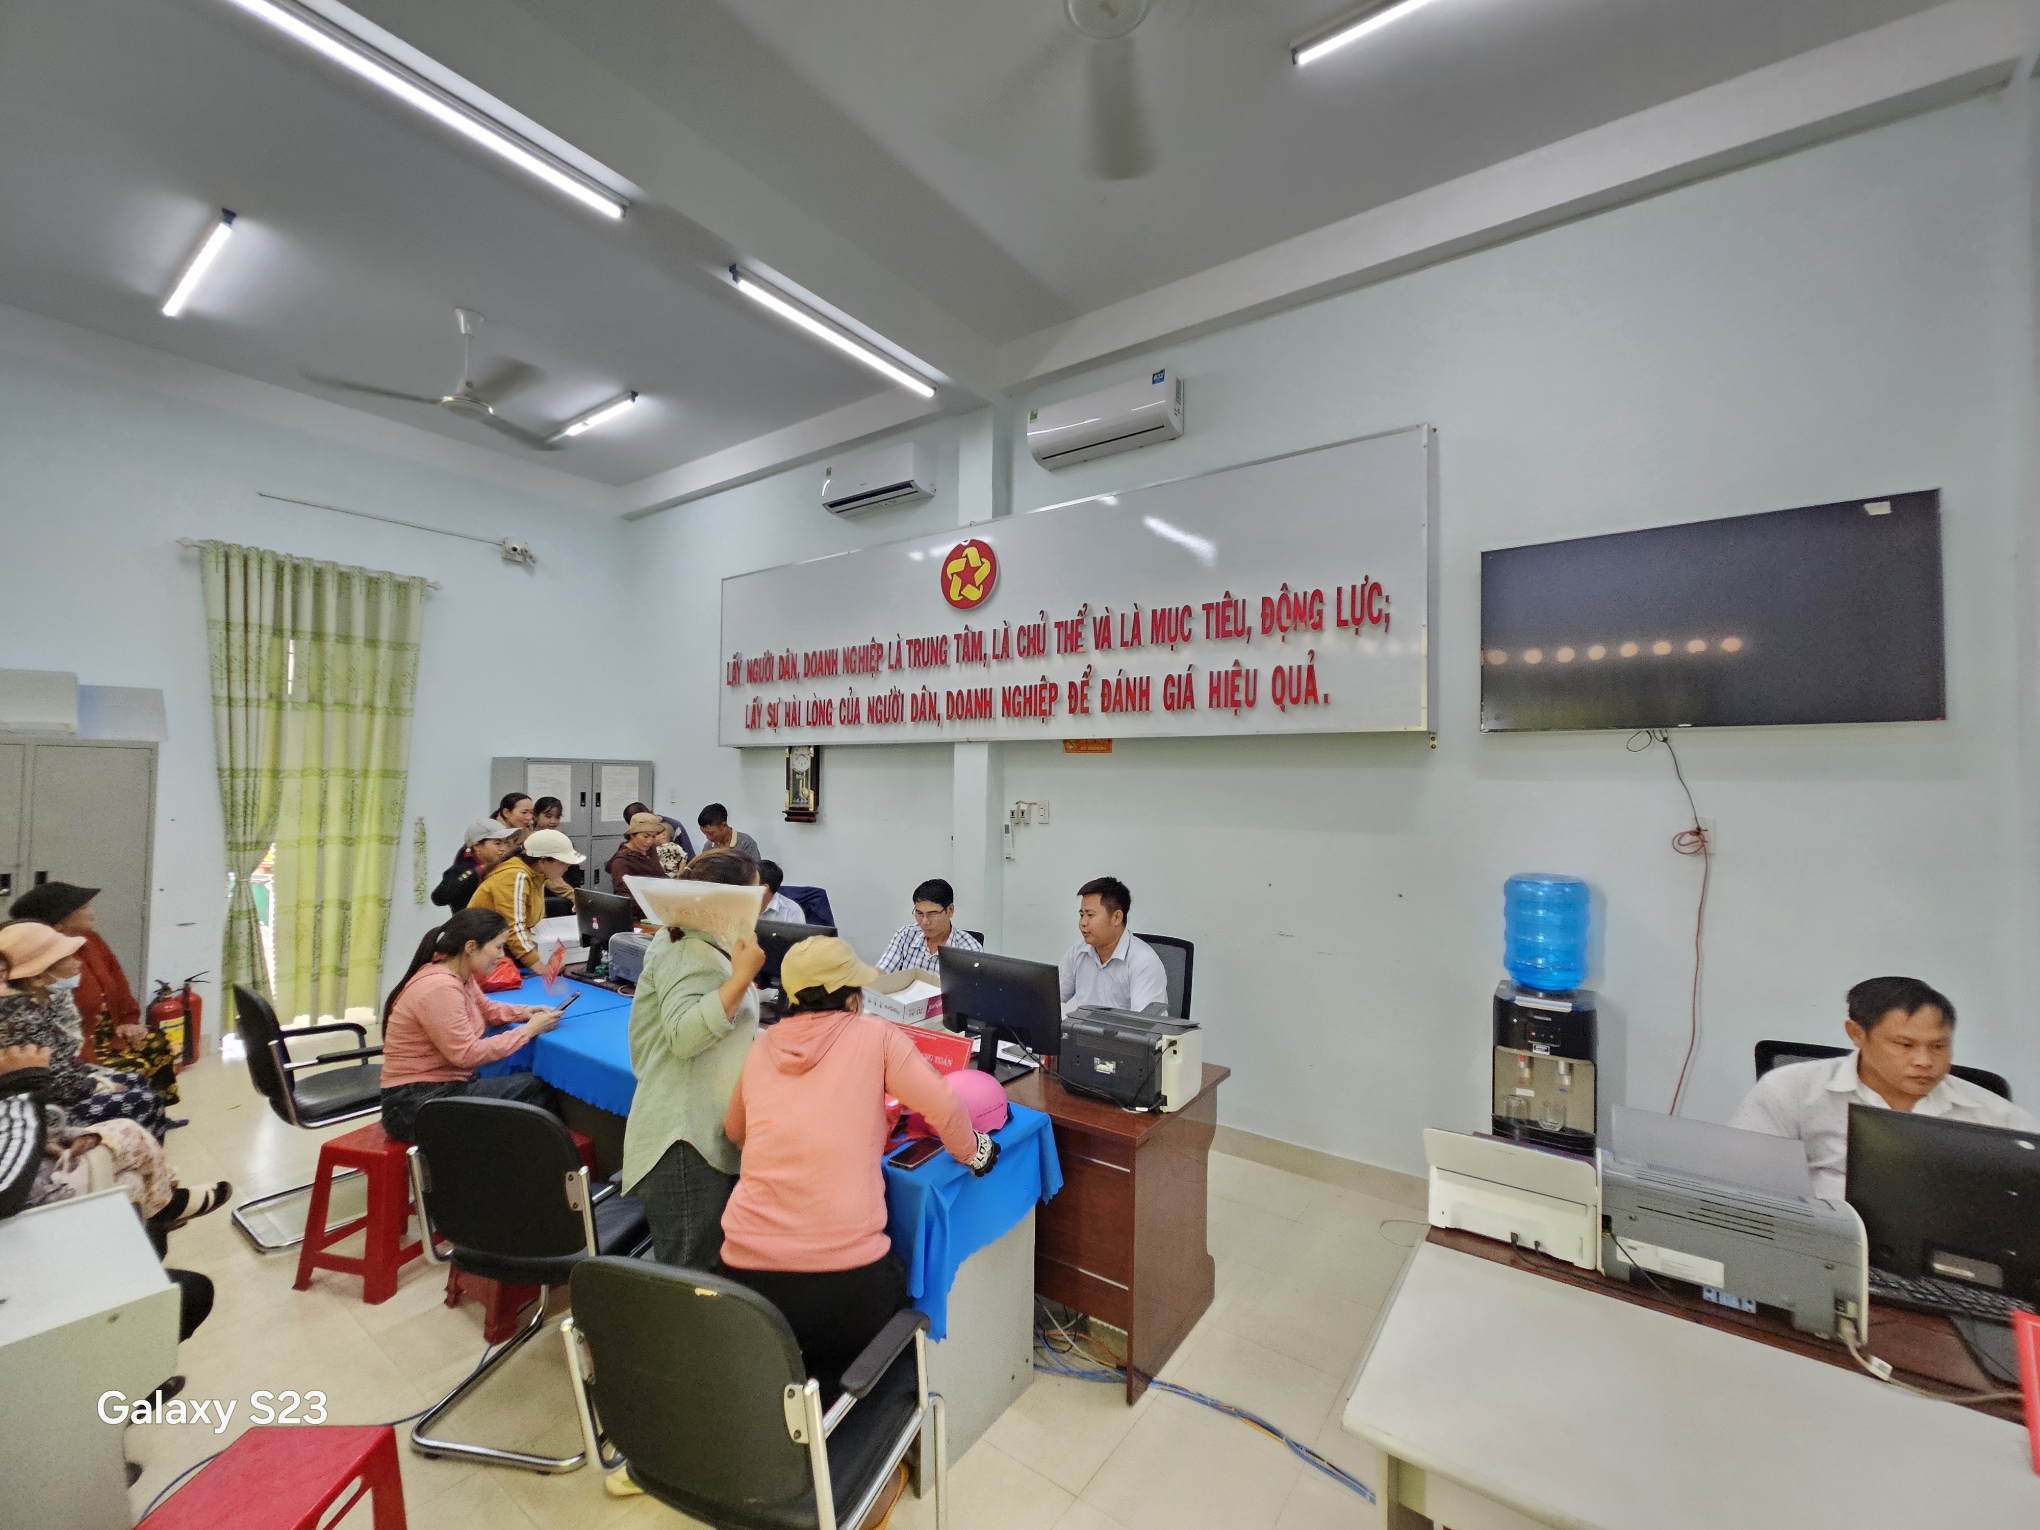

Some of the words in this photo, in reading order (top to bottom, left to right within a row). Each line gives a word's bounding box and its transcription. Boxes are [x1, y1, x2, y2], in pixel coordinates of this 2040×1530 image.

[726, 652, 744, 686] LẤY
[746, 648, 775, 684] NGƯỜI
[778, 648, 801, 684] DÂN,
[803, 648, 839, 678] DOANH
[842, 637, 884, 678] NGHIỆP
[888, 633, 904, 671] LÀ
[906, 635, 949, 668] TRUNG
[954, 624, 988, 668] TÂM,
[992, 620, 1010, 661] LÀ
[1016, 610, 1047, 659] CHỦ
[1054, 602, 1088, 655] THỂ
[1093, 606, 1112, 651] VÀ
[1120, 603, 1142, 648] LÀ
[1151, 604, 1193, 652] MỤC
[1202, 590, 1252, 644] TIÊU,
[1260, 582, 1325, 643] ĐỘNG
[1336, 574, 1392, 635] LỰC;
[745, 695, 763, 729] LẤY
[767, 698, 781, 734] SỰ
[785, 694, 801, 727] HÀI
[806, 693, 833, 727] LÒNG
[839, 687, 861, 725] CỦA
[867, 686, 905, 724] NGƯỜI
[910, 685, 942, 727] DÂN,
[946, 687, 994, 721] DOANH
[1001, 675, 1059, 723] NGHIỆP
[1068, 664, 1092, 715] ĐỂ
[1101, 669, 1151, 714] ĐÁNH
[1163, 664, 1195, 711] GIÁ
[1208, 659, 1258, 716] HIỆU
[1272, 650, 1331, 713] QUẢ.
